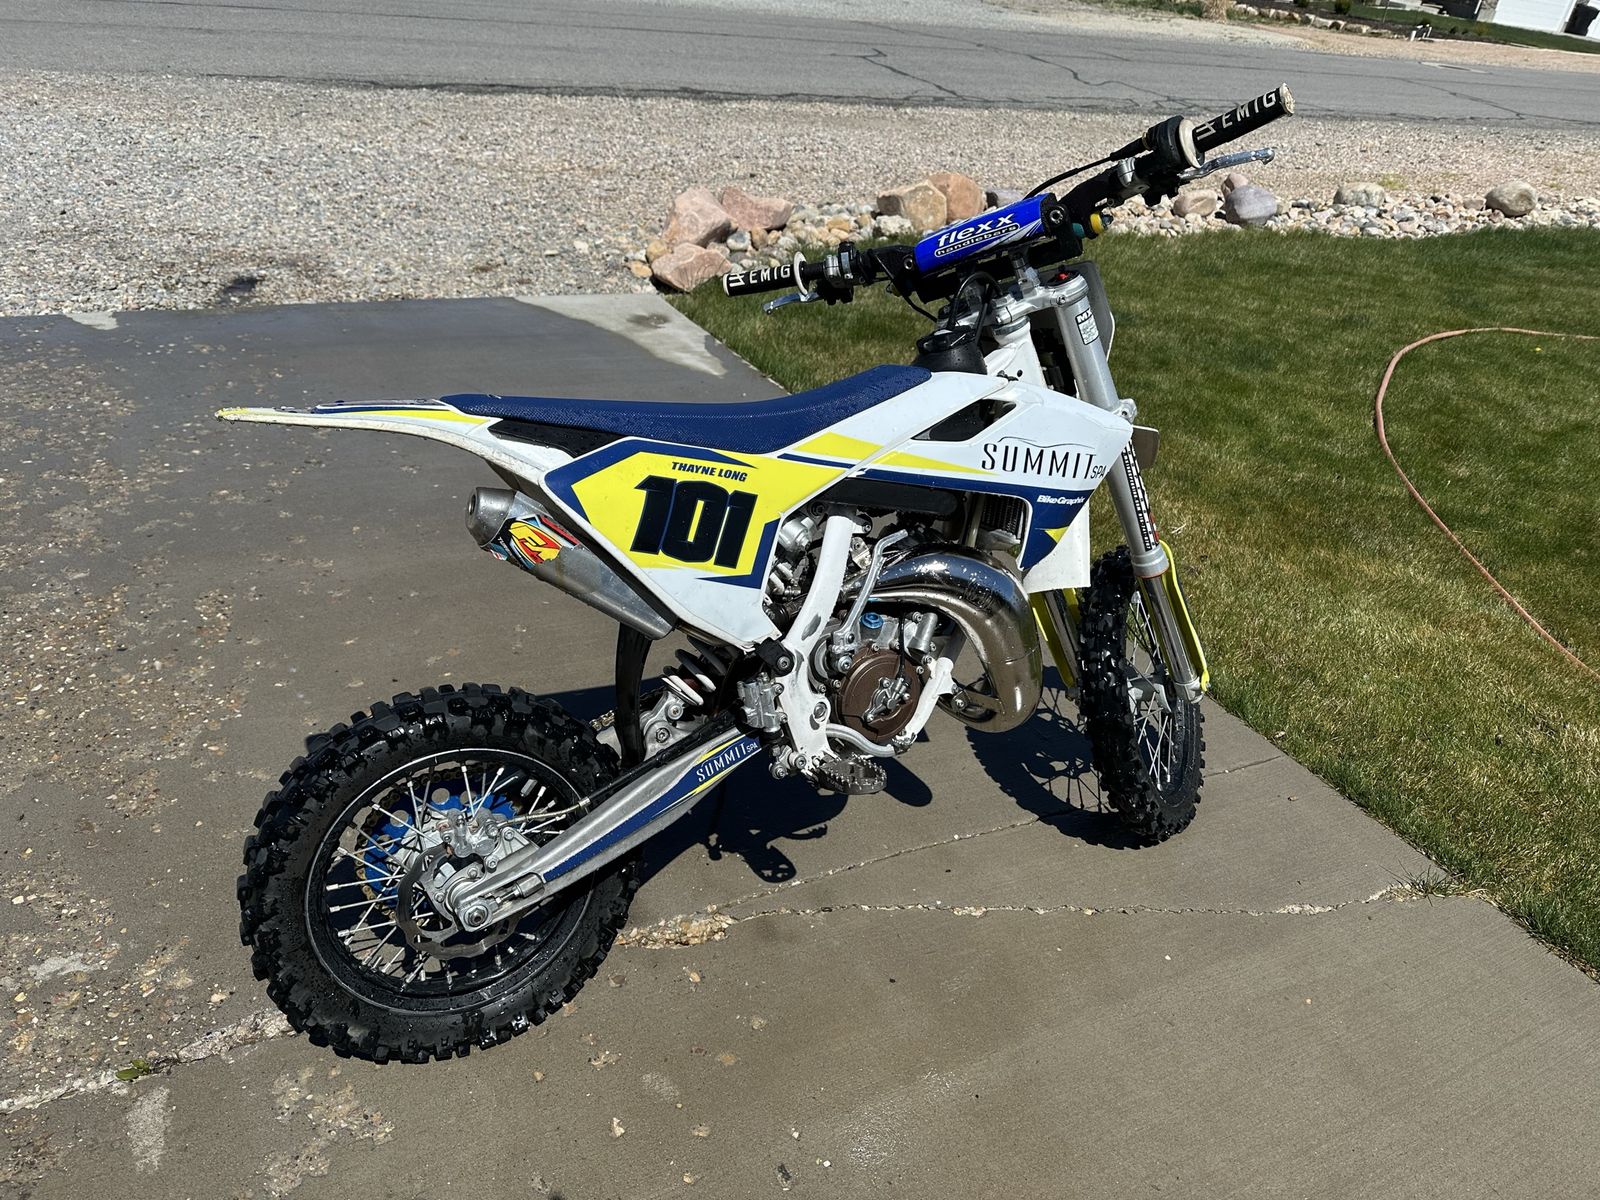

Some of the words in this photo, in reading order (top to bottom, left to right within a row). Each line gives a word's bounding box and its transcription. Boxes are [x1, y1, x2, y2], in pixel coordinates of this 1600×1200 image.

[1222, 92, 1277, 129] EMIG
[936, 224, 1018, 256] handlebars
[938, 213, 1014, 247] flexx
[749, 264, 791, 284] EMIG
[671, 461, 716, 477] THAYNE
[717, 468, 748, 482] LONG
[981, 443, 1096, 479] SUMMIT
[1090, 465, 1107, 479] SPA
[630, 474, 758, 569] 101
[696, 742, 746, 781] SUMMIT
[745, 742, 758, 753] SPA
